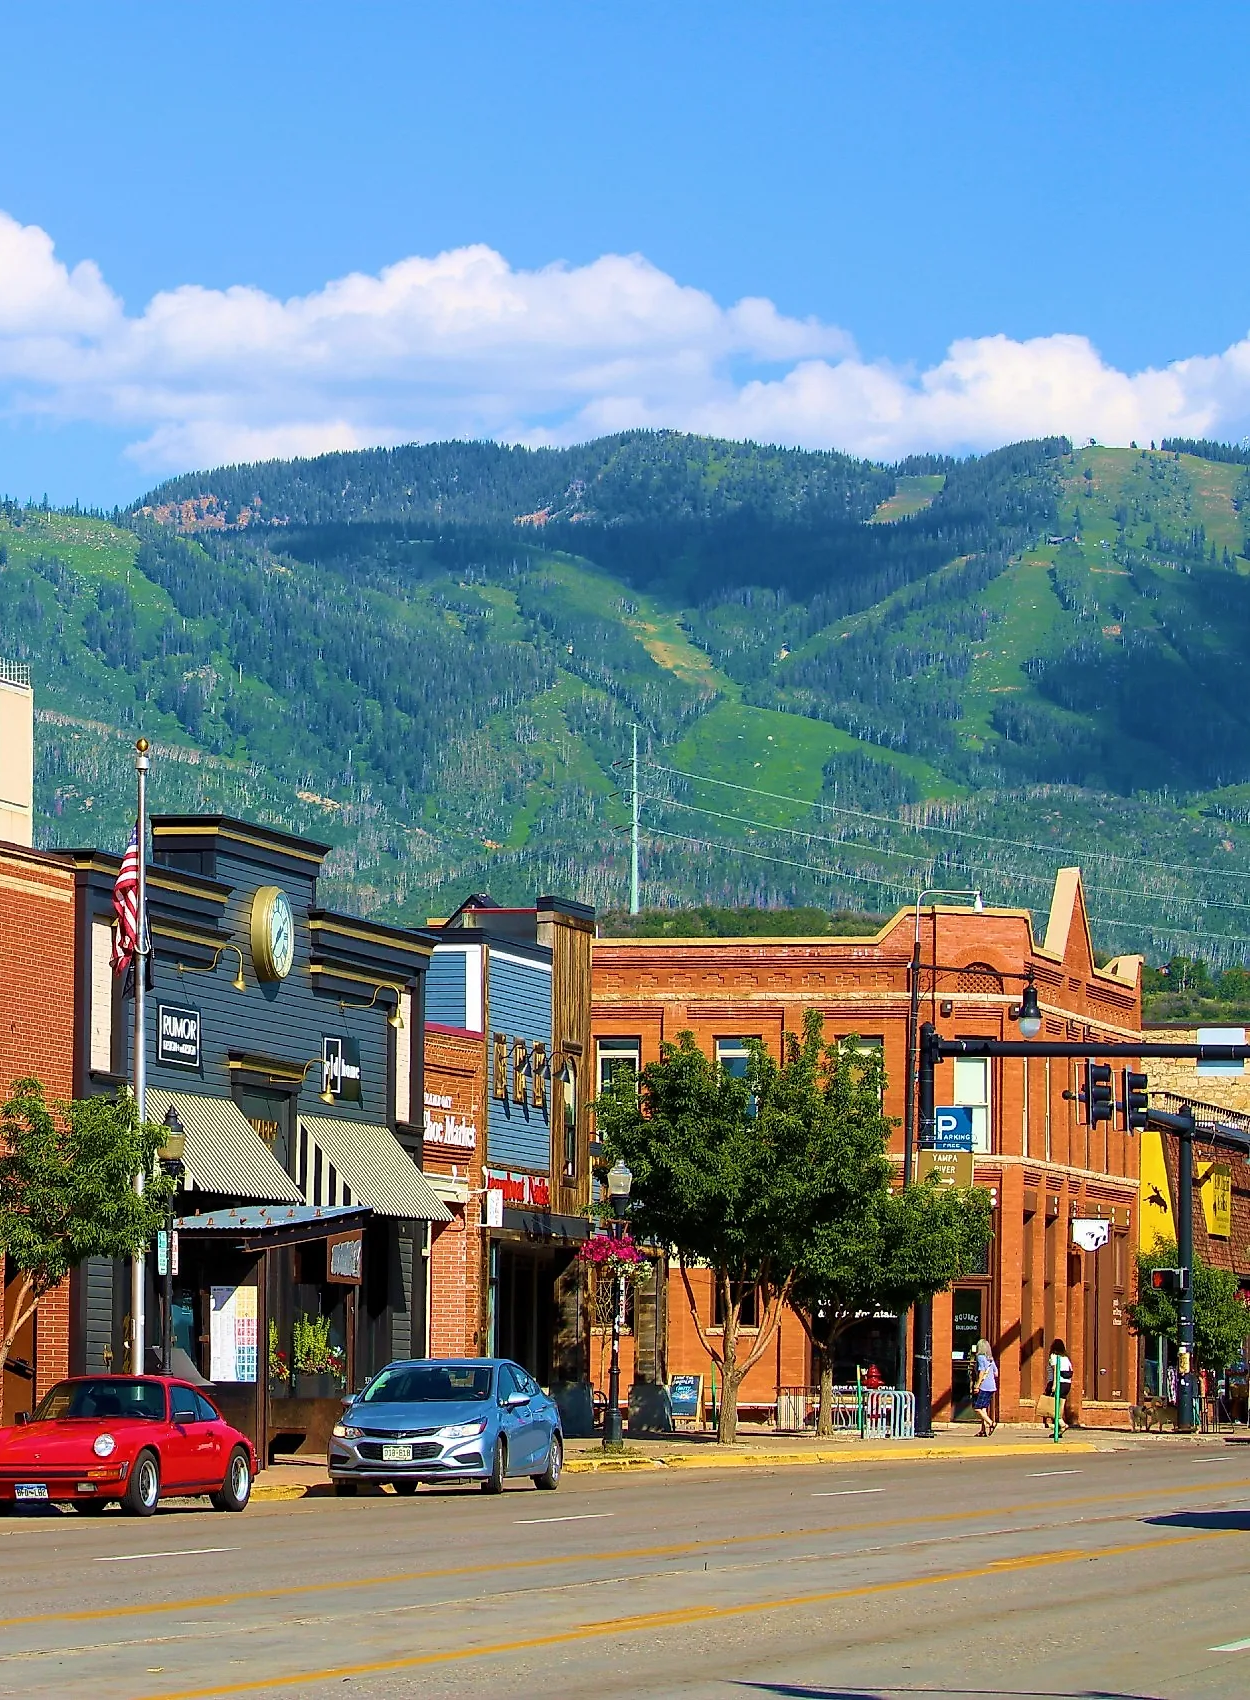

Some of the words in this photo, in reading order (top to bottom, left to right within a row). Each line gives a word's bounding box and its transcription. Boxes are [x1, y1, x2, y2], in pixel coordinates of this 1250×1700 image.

[162, 1014, 197, 1041] RUMOR
[443, 1114, 477, 1148] Market
[932, 1153, 959, 1163] YAMPA
[934, 1165, 956, 1175] RIVER
[954, 1313, 979, 1323] SQUIRE
